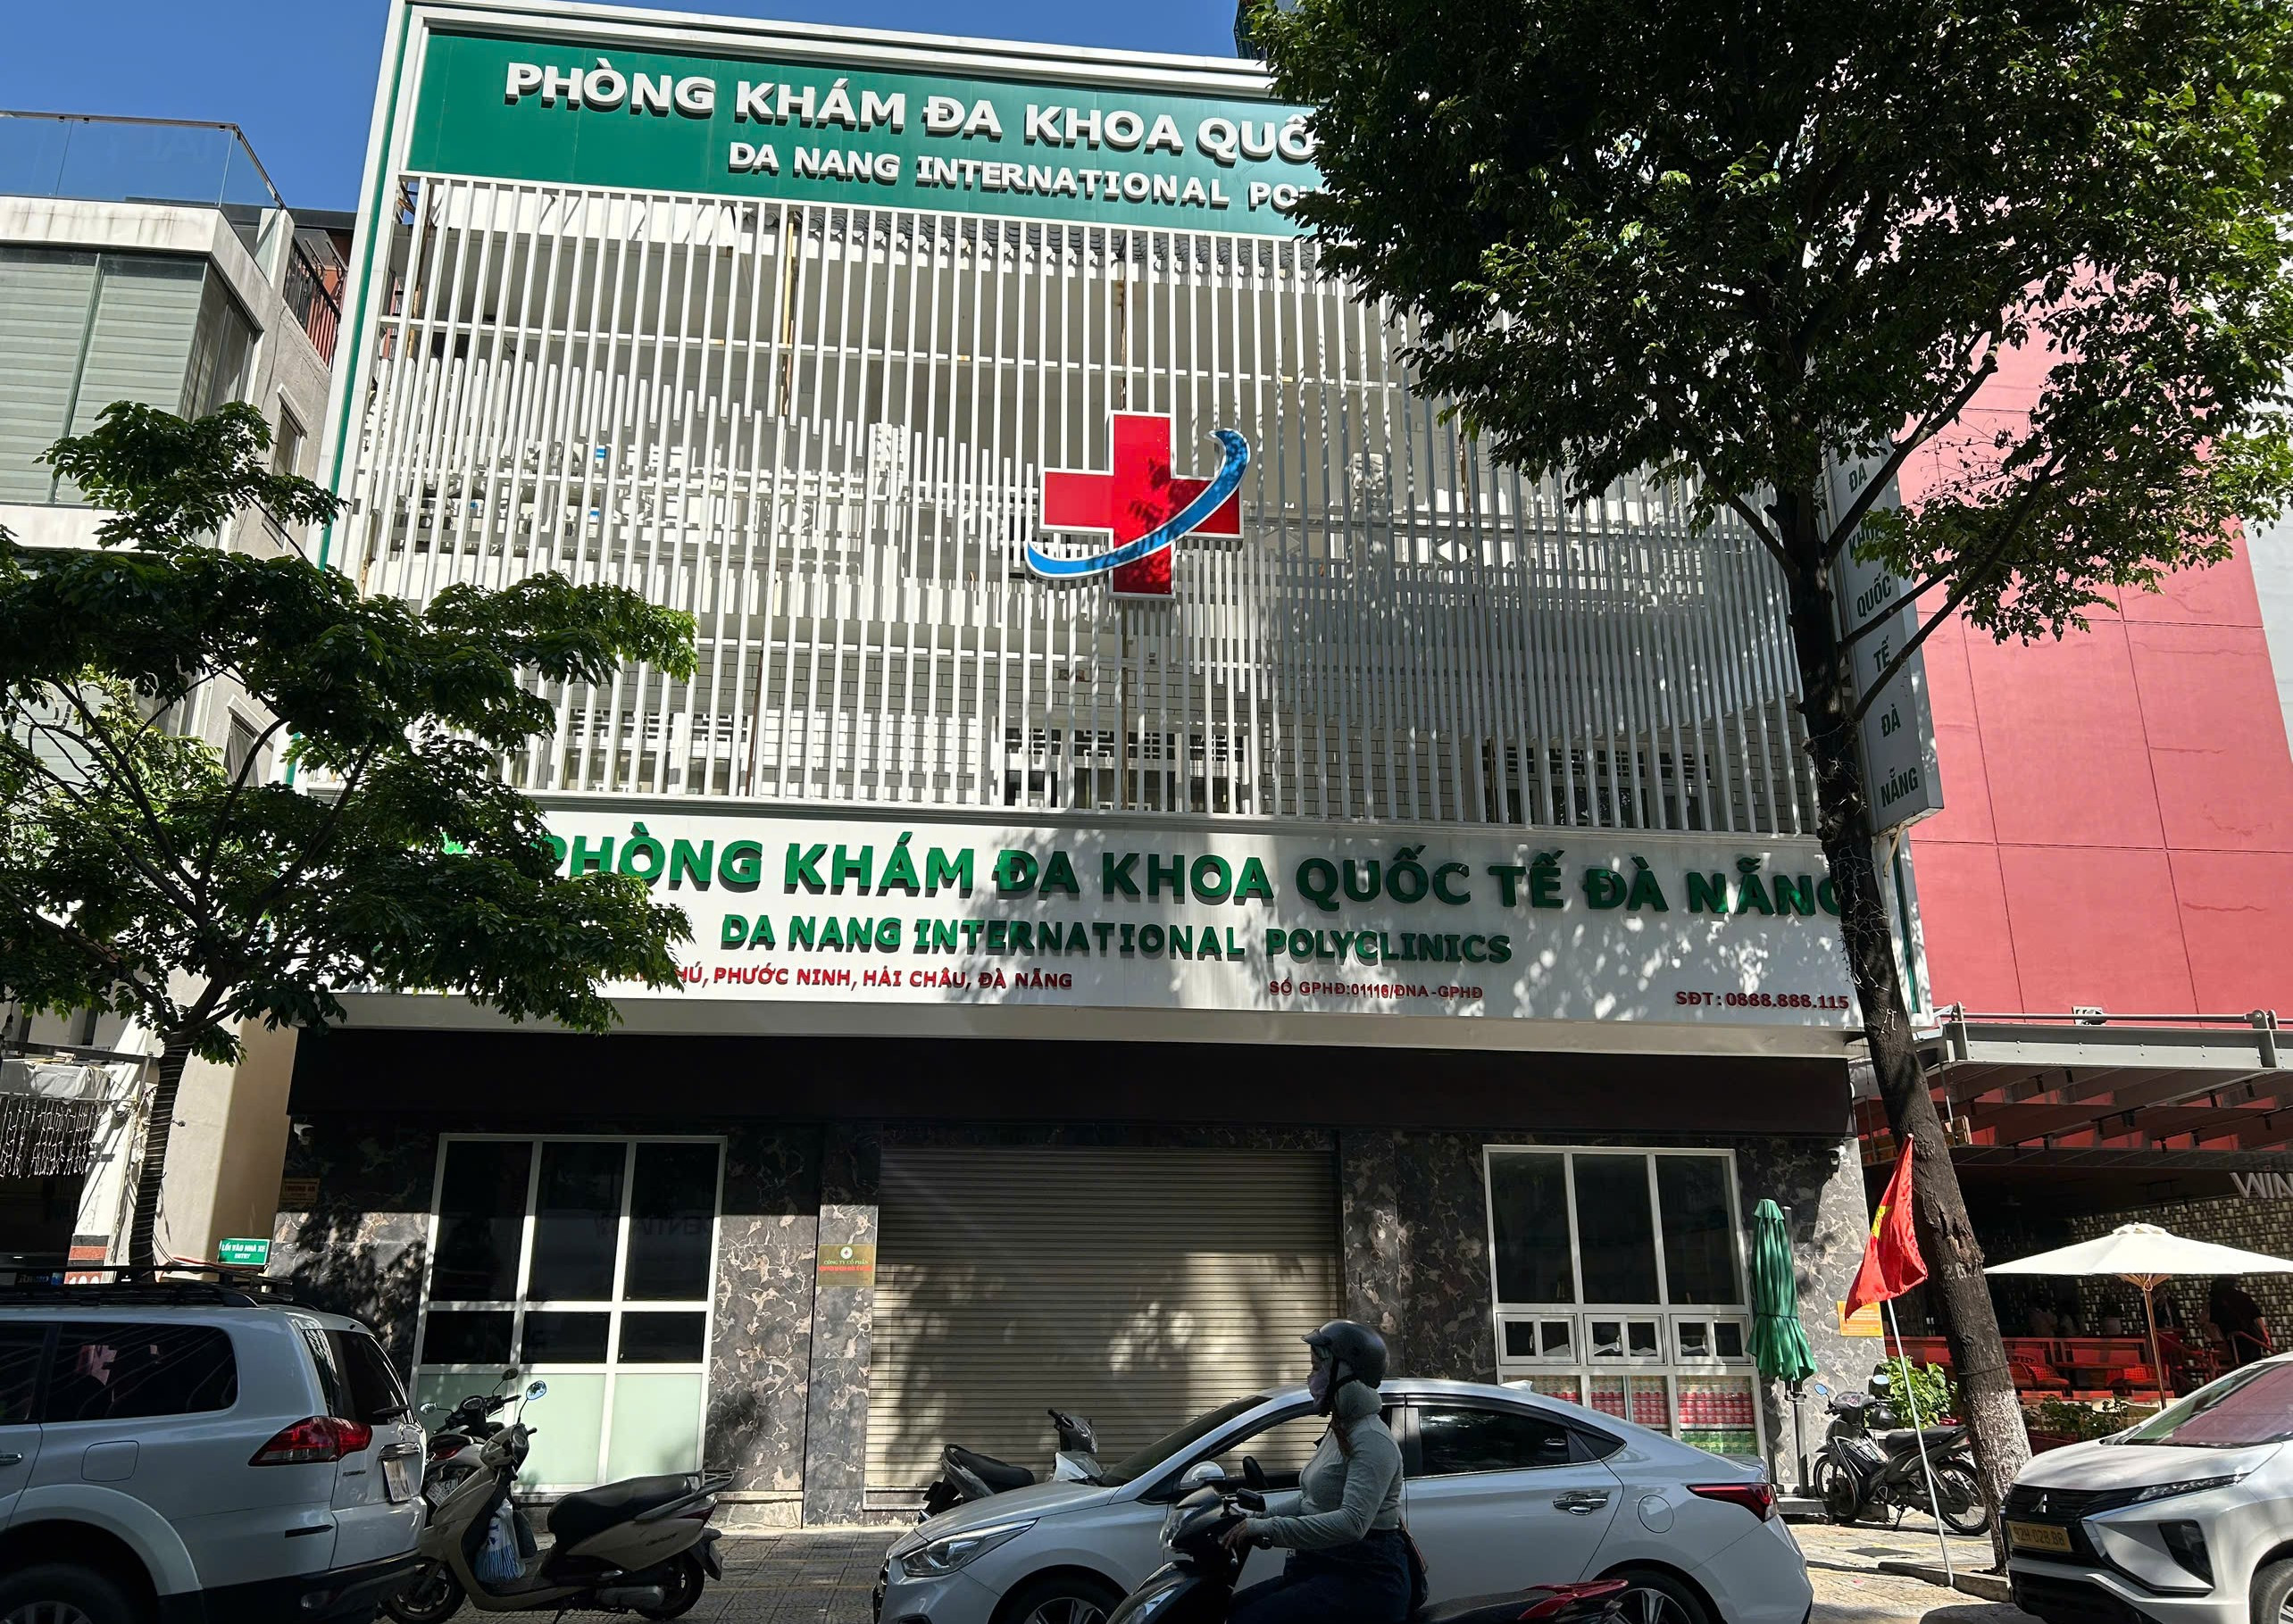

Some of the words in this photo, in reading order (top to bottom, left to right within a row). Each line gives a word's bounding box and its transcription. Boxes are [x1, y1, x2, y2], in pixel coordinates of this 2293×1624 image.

[505, 58, 714, 116] PHÒNG
[735, 79, 905, 134] KHÁM
[922, 96, 1002, 138] ĐA
[1025, 103, 1183, 153] KHOA
[728, 142, 779, 176] DA
[794, 146, 900, 183] NANG
[915, 155, 1230, 209] INTERNATIONAL
[1856, 572, 1891, 618] QUỐC
[1874, 635, 1891, 672] TẾ
[1881, 704, 1901, 737] ĐÀ
[1880, 767, 1919, 808] NẴNG
[784, 831, 974, 898] KHÁM
[993, 849, 1080, 900] ĐA
[1102, 852, 1274, 905] KHOA
[1296, 845, 1471, 912] QUỐC
[1488, 850, 1564, 909] TẾ
[1582, 855, 1669, 912] ĐÀ
[721, 914, 775, 950] DA
[788, 916, 901, 954] NANG
[913, 919, 1245, 961] INTERNATIONAL
[1265, 928, 1512, 964] POLYCLINICS
[714, 962, 788, 985] PHƯỚC
[796, 969, 857, 991] NINH,
[909, 967, 971, 992] CHÂU,
[978, 968, 1007, 989] ĐÀ
